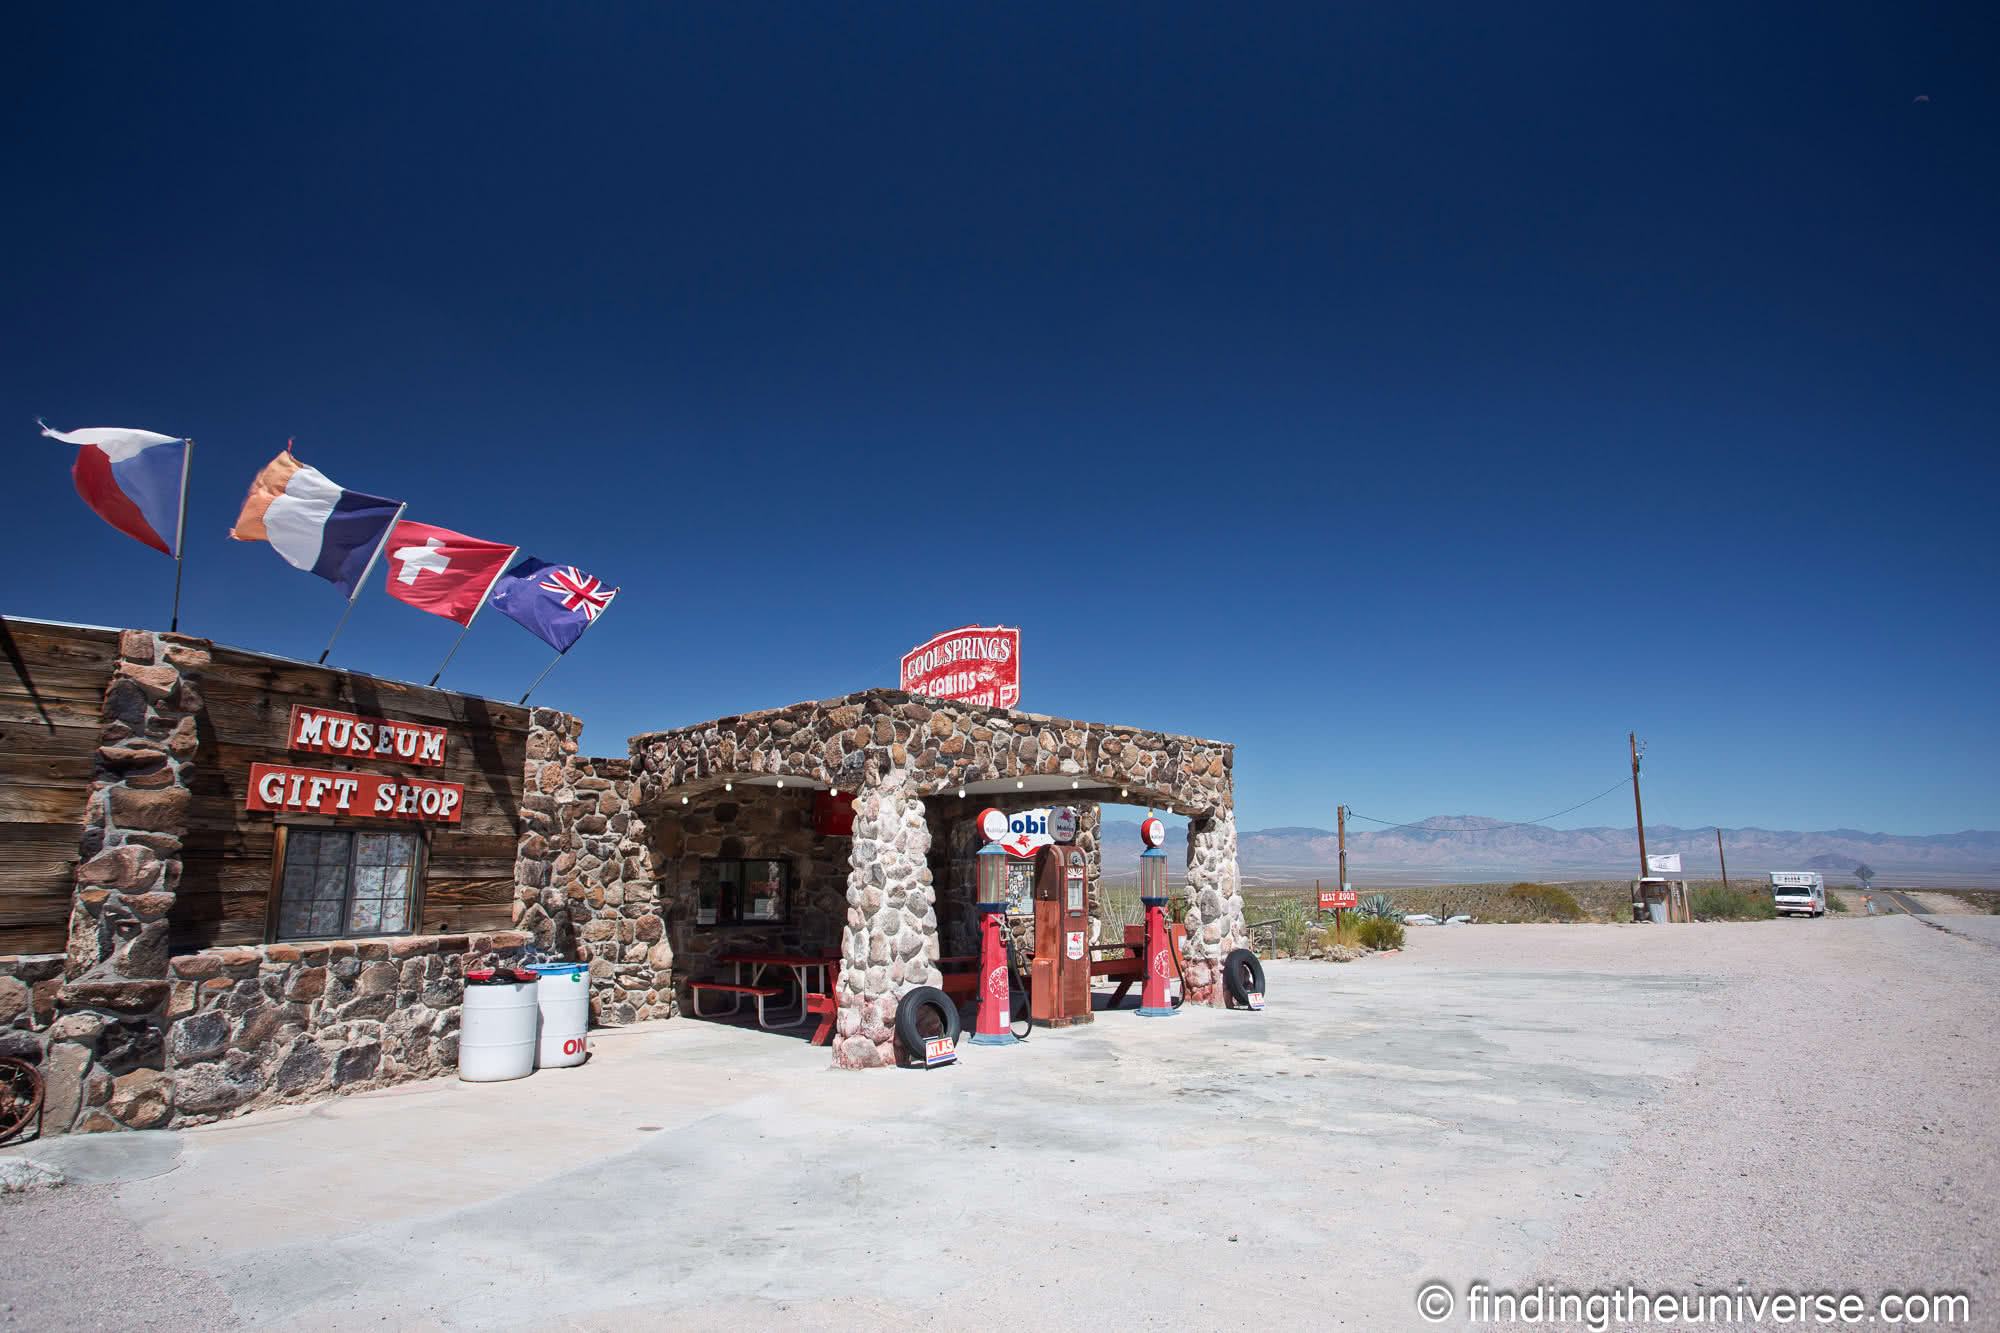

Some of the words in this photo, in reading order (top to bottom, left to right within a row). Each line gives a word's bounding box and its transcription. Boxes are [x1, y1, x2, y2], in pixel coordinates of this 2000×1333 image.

[907, 647, 942, 680] COOL
[943, 637, 1010, 664] SPRINGS
[296, 712, 444, 761] MUSEUM
[258, 772, 358, 809] GIFT
[374, 783, 459, 816] SHOP
[927, 1039, 954, 1057] ATLAS
